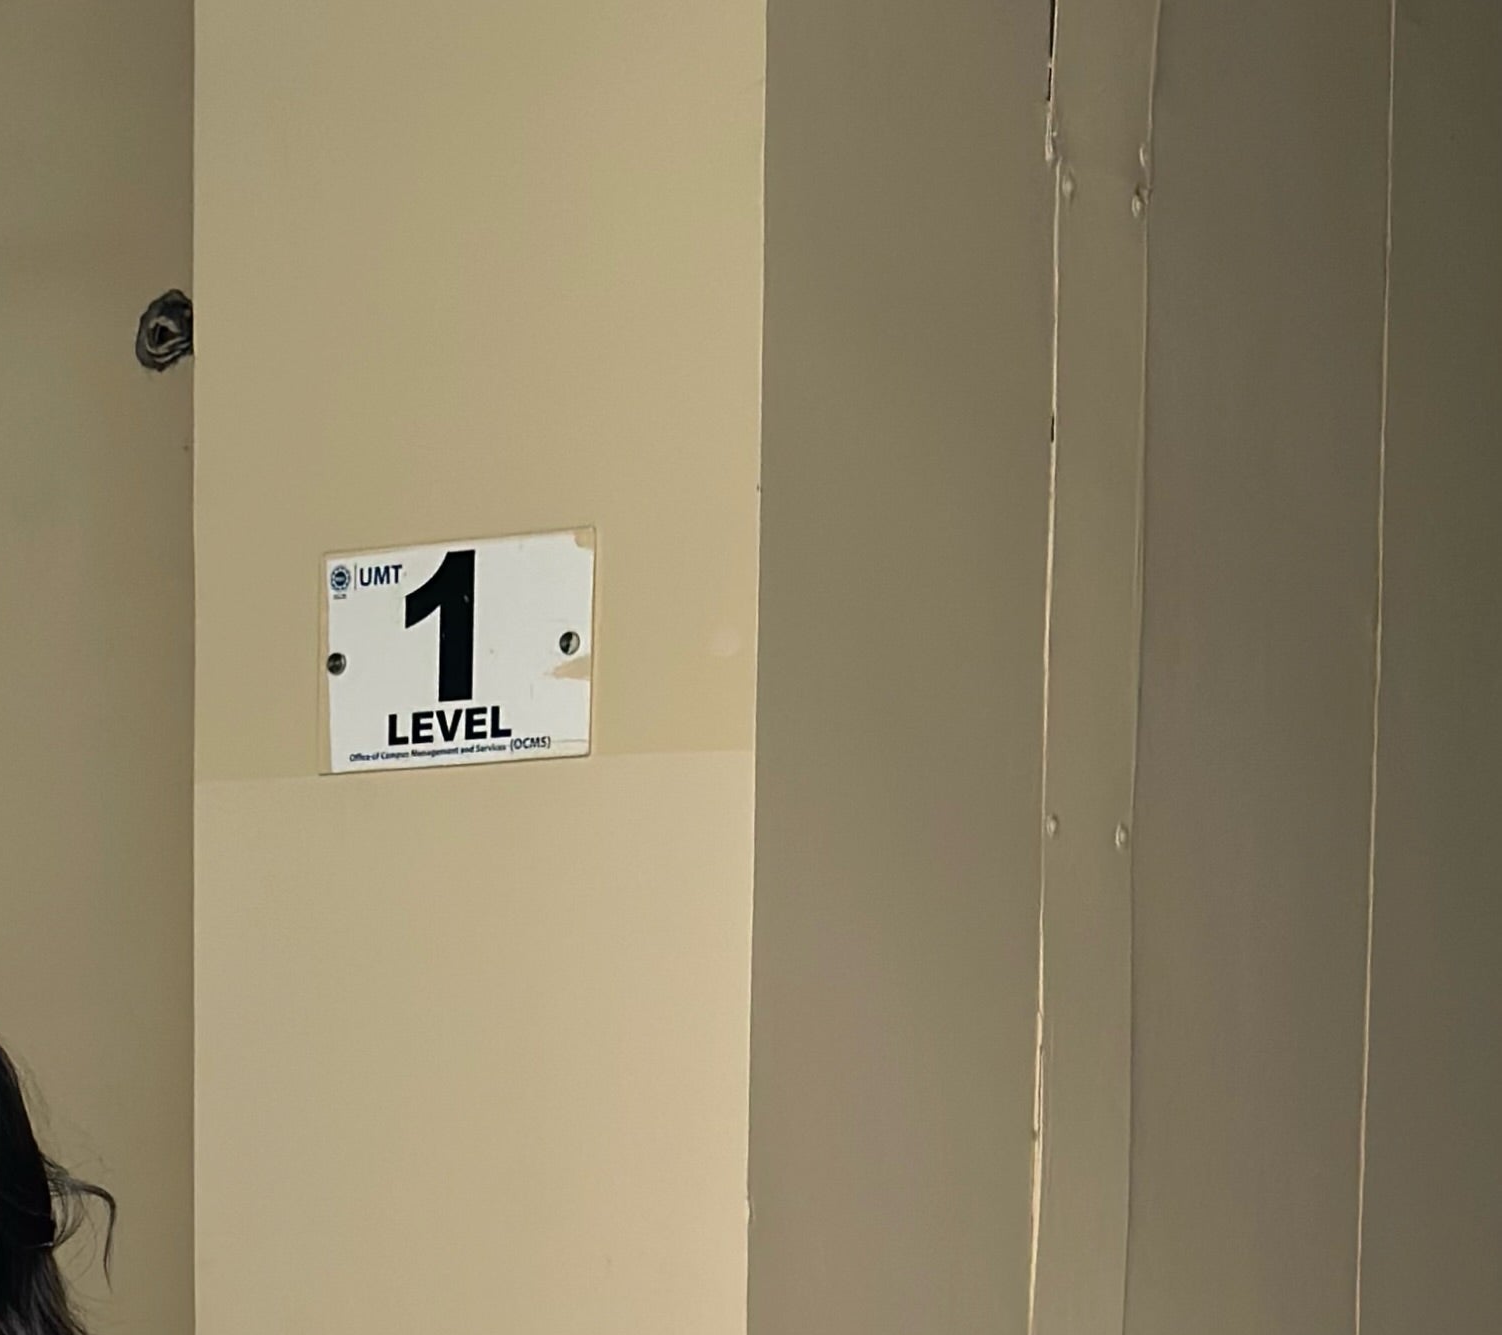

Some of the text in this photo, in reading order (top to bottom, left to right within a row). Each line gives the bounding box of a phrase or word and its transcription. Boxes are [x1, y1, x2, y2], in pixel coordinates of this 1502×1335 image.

[359, 564, 403, 587] UMT
[405, 549, 475, 702] 1
[388, 706, 512, 746] LEVEL
[510, 736, 551, 752] (OCMS)
